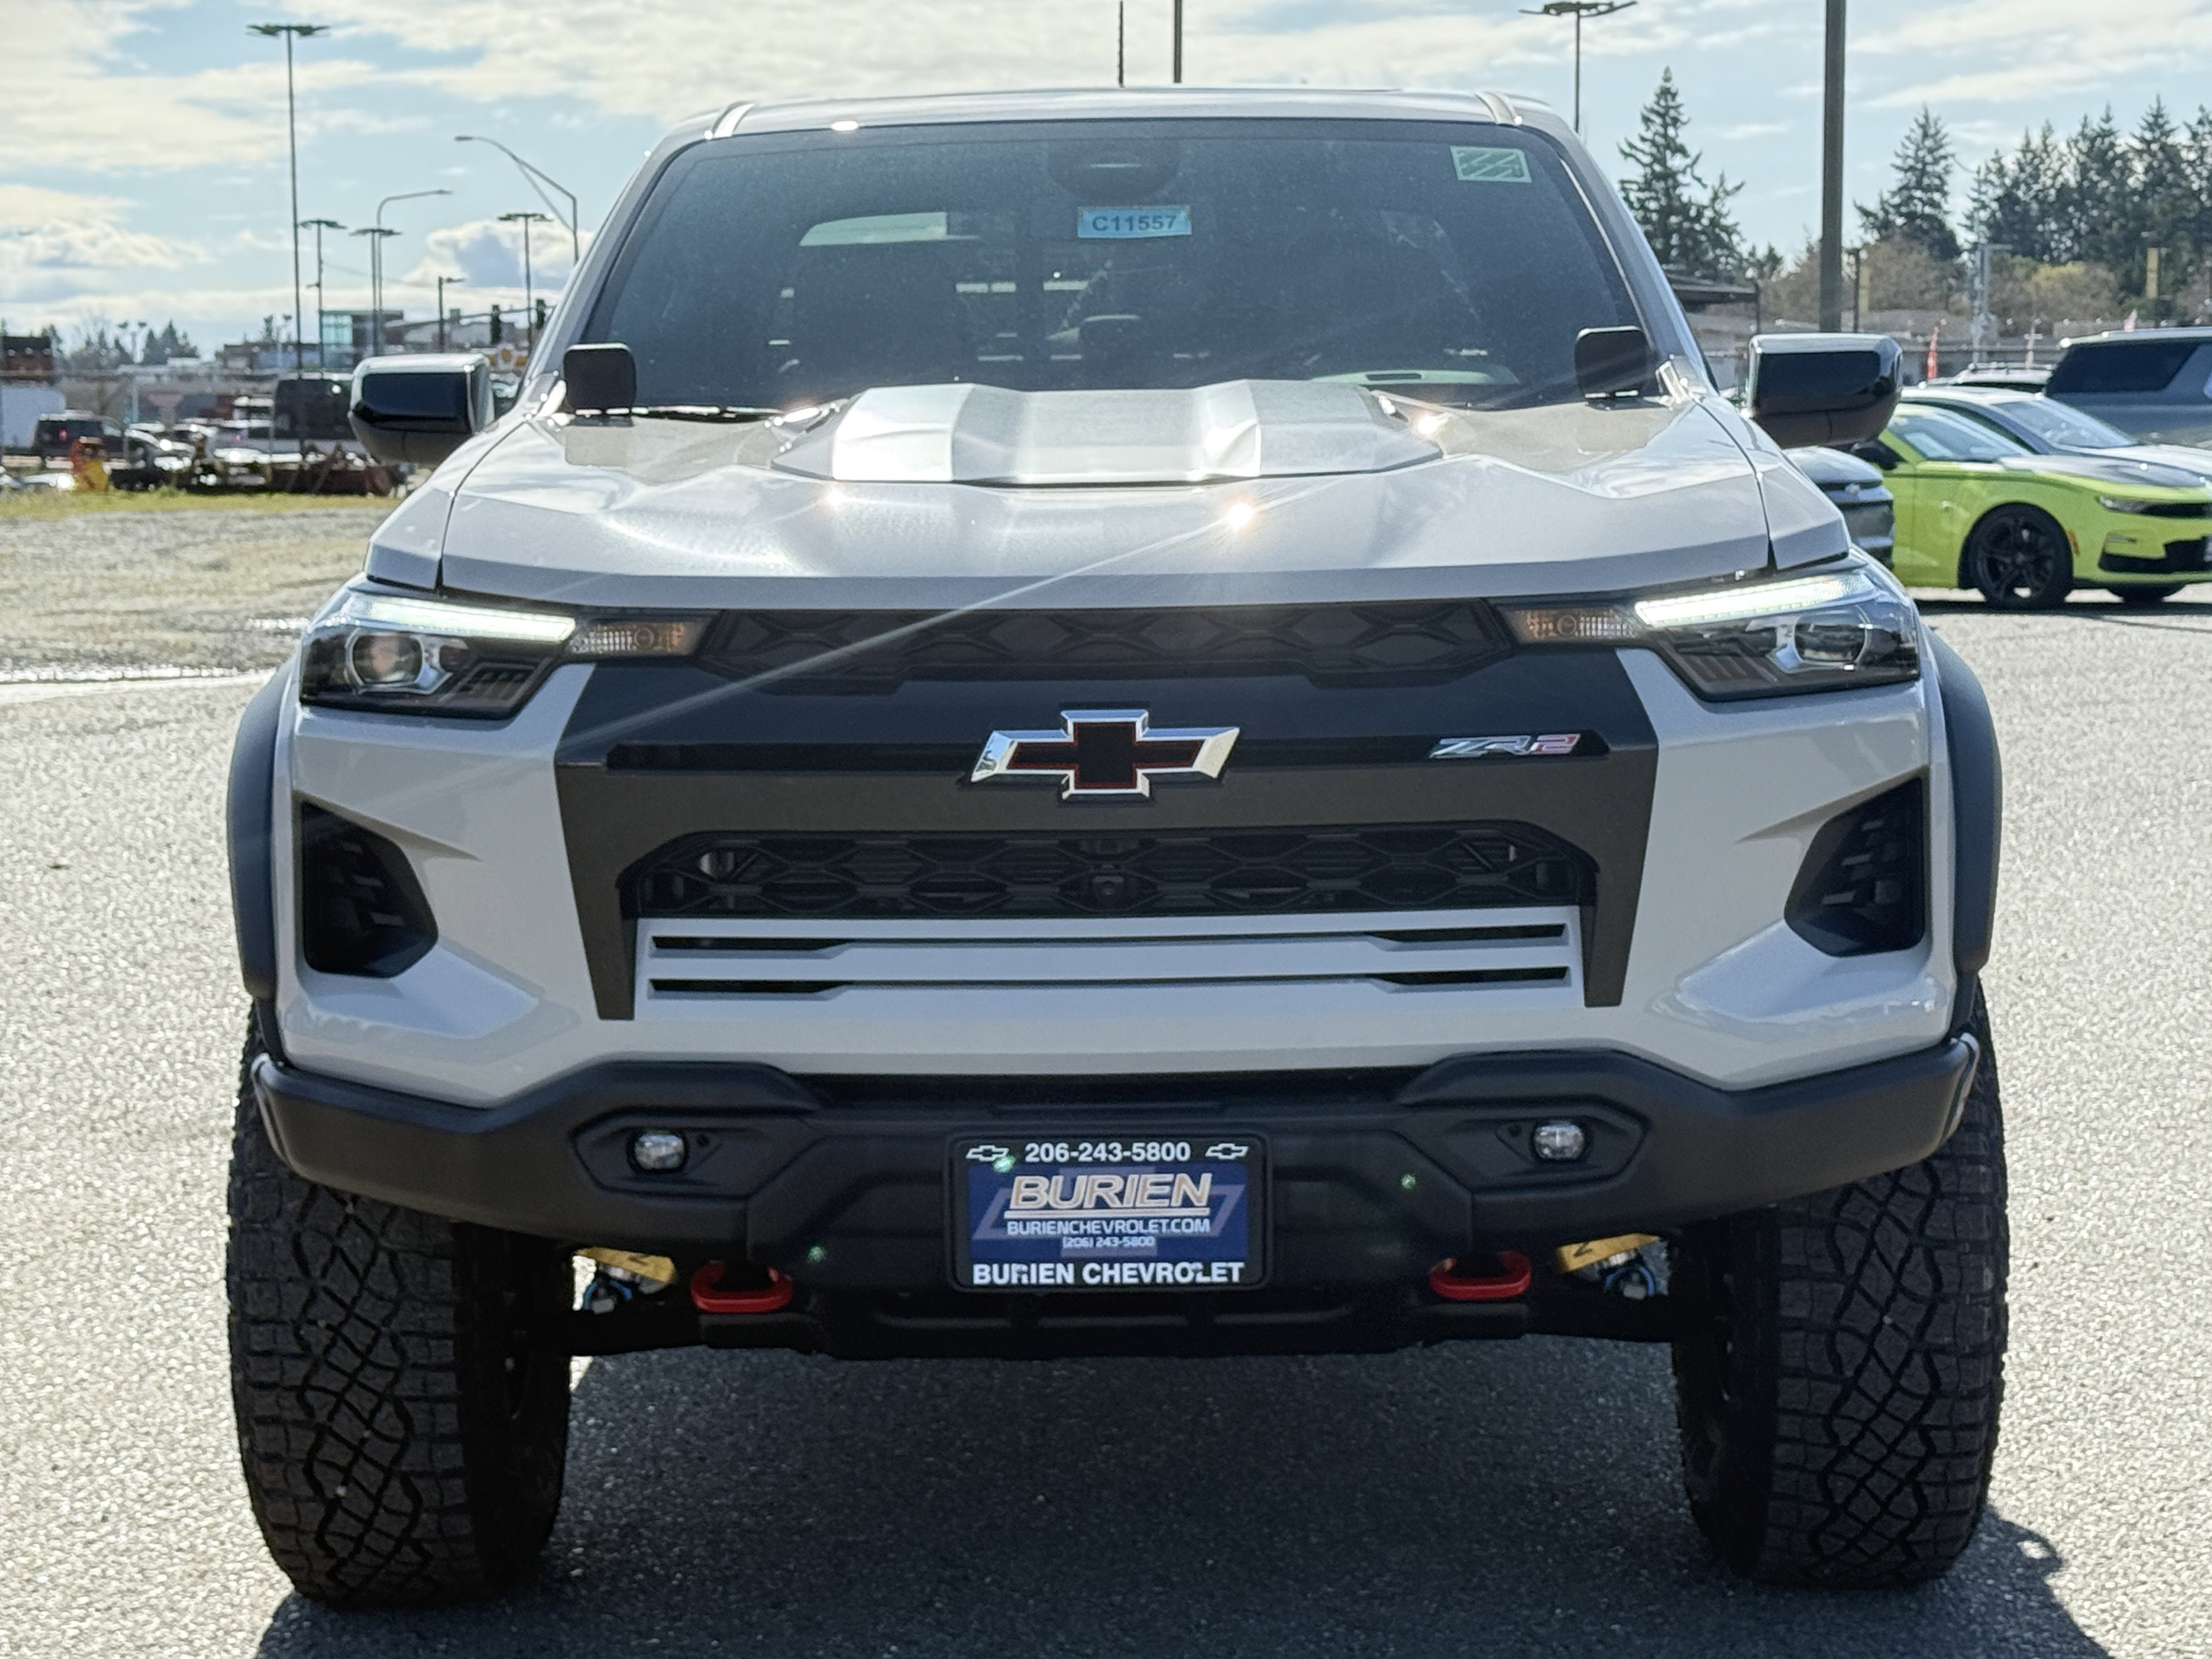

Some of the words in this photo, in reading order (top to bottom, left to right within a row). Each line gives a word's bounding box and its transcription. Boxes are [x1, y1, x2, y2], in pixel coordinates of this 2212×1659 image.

[1092, 215, 1177, 232] C11557
[1429, 733, 1581, 759] ZR2
[1025, 1142, 1191, 1163] 206-243-5800
[1009, 1173, 1212, 1210] BURIEN
[1007, 1218, 1211, 1236] BURIENCHEVROLET.COM
[1096, 1235, 1155, 1248] 243-5800
[973, 1263, 1075, 1285] BURIEN
[1082, 1262, 1245, 1284] CHEVROLET
